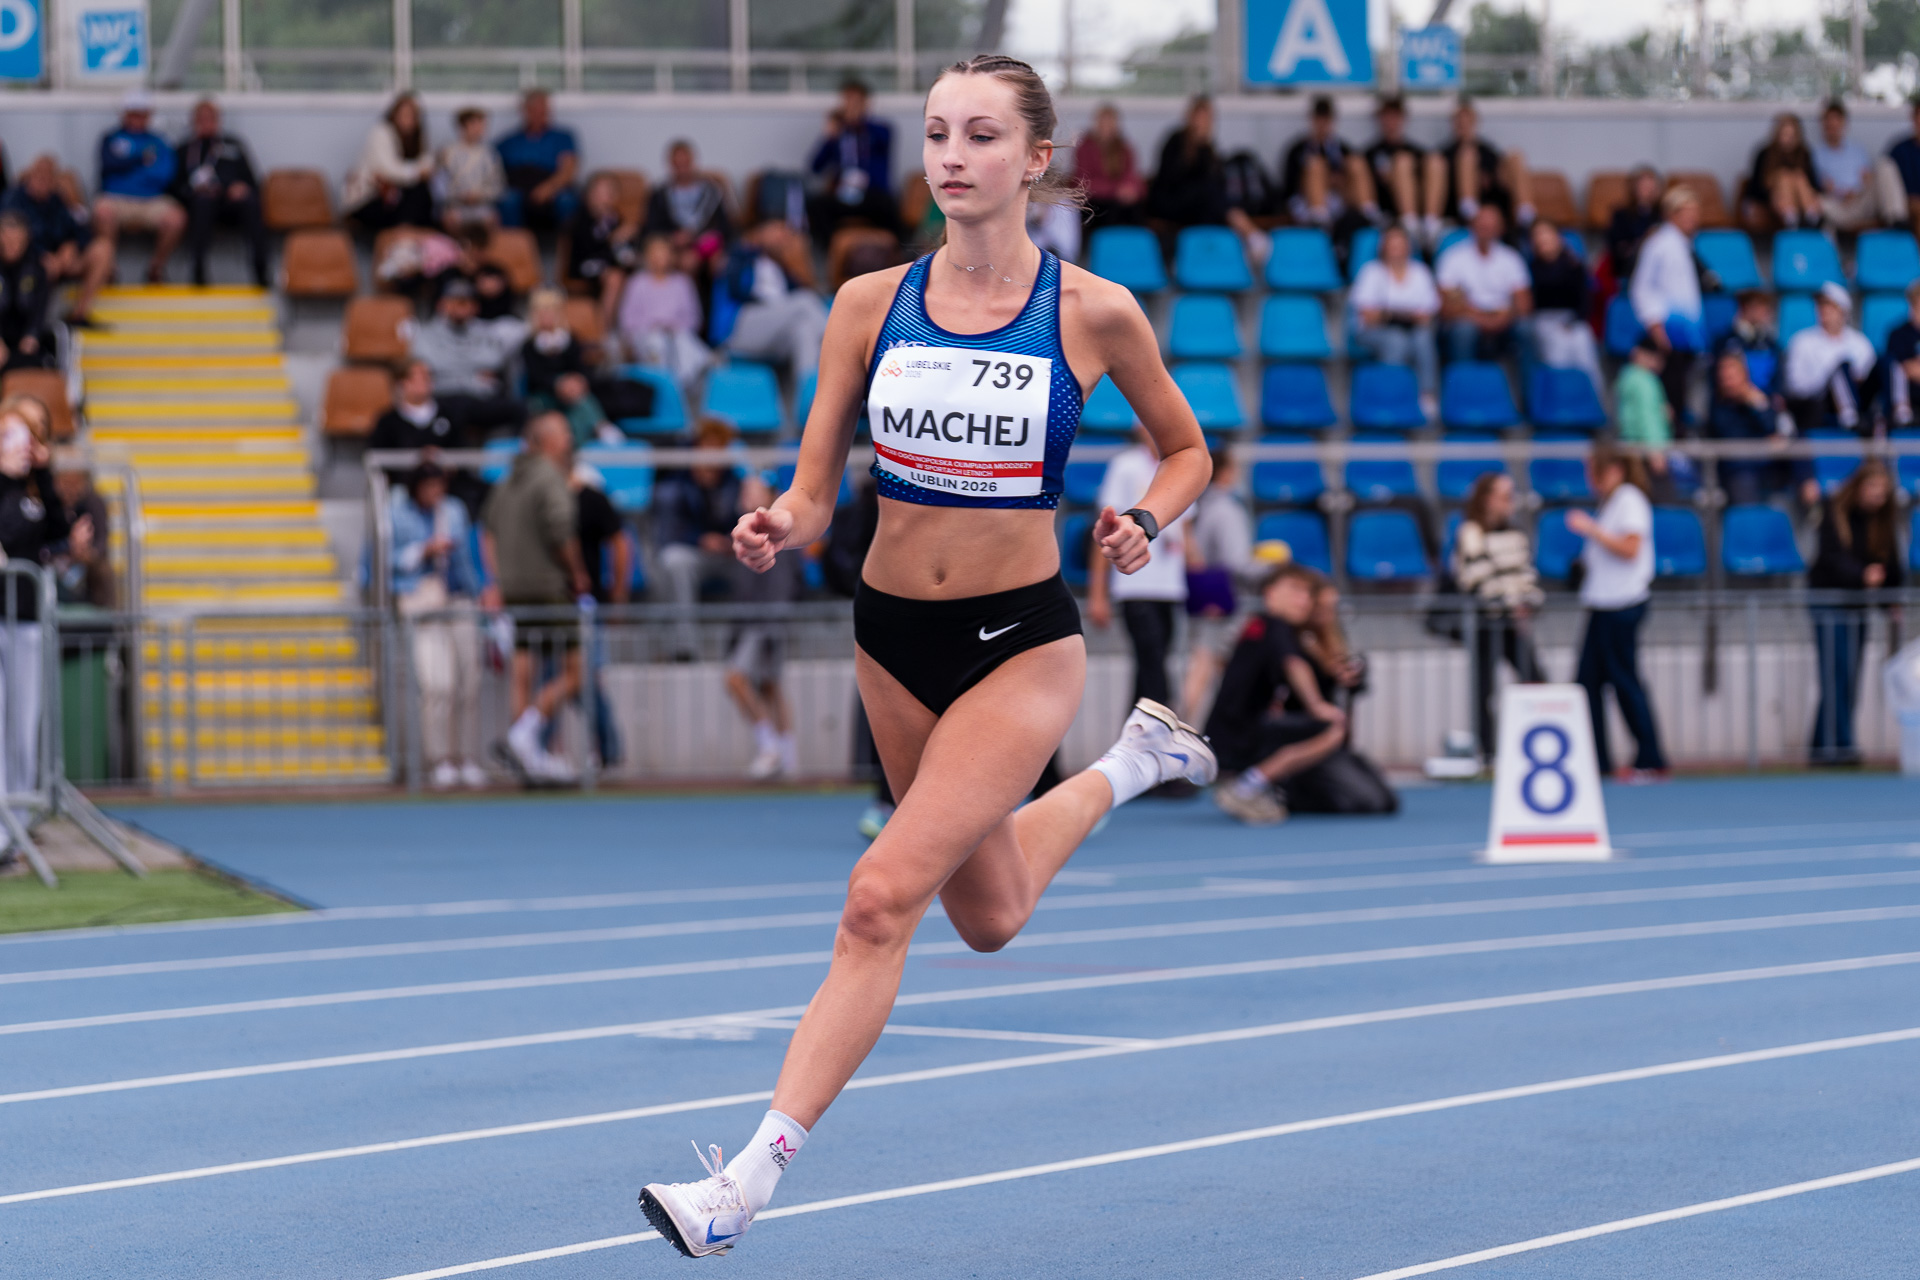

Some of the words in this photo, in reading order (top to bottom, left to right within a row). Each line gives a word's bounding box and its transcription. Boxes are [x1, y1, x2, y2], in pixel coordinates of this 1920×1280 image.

[0, 0, 37, 51] D
[1268, 0, 1352, 78] A
[906, 360, 952, 371] LUBELSKIE
[972, 359, 1033, 390] 739
[882, 405, 1029, 447] MACHEJ
[897, 451, 953, 466] OGÓLNOPOLSKA
[953, 460, 993, 470] OLIMPIADA
[993, 461, 1033, 470] MŁODZIEŻY
[924, 463, 962, 476] SPORTACH
[963, 469, 993, 477] LETNICH
[910, 471, 957, 490] LUBLIN
[961, 480, 998, 492] 2026
[1521, 723, 1575, 815] 8
